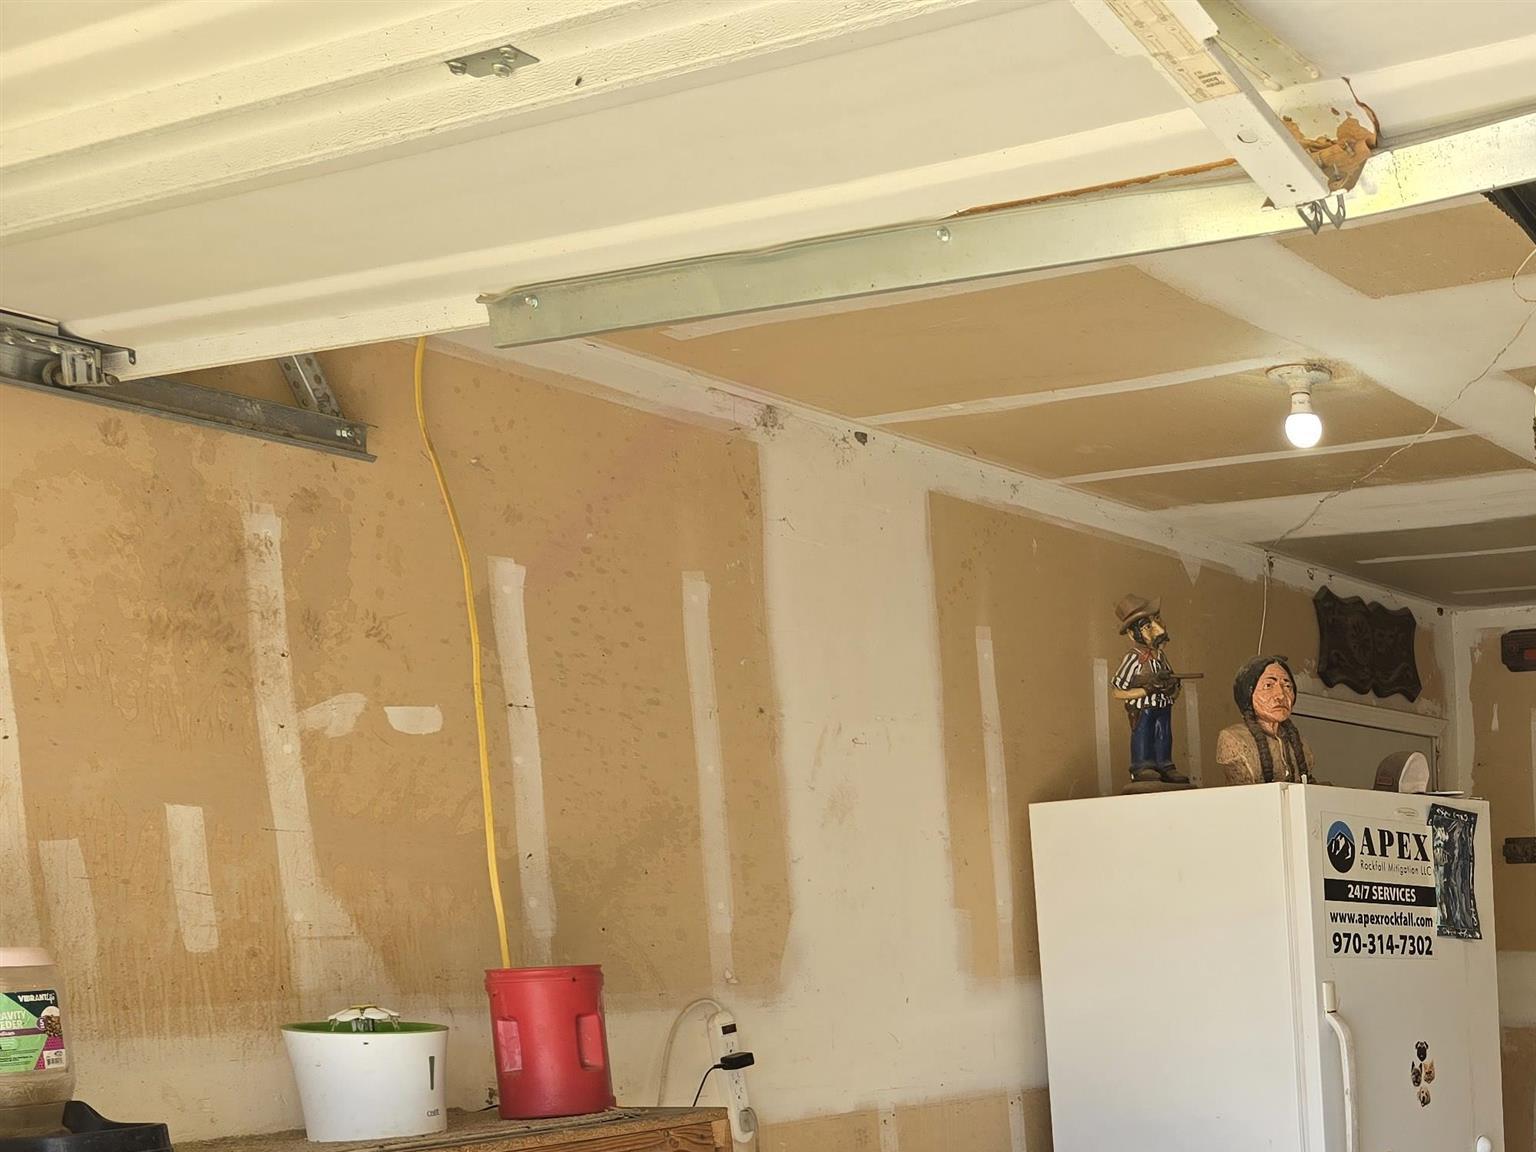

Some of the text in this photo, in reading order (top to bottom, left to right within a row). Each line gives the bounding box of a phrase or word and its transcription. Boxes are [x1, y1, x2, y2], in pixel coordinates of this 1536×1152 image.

[1359, 827, 1431, 862] APEX
[1360, 859, 1432, 876] Rockfall Mitigation LLC
[1347, 884, 1416, 903] 24/7 SERVICES
[1330, 911, 1433, 928] www.apexrockfall.com
[1332, 932, 1433, 956] 970-314-7302
[0, 1010, 26, 1020] AVITY
[0, 1020, 23, 1029] EDER
